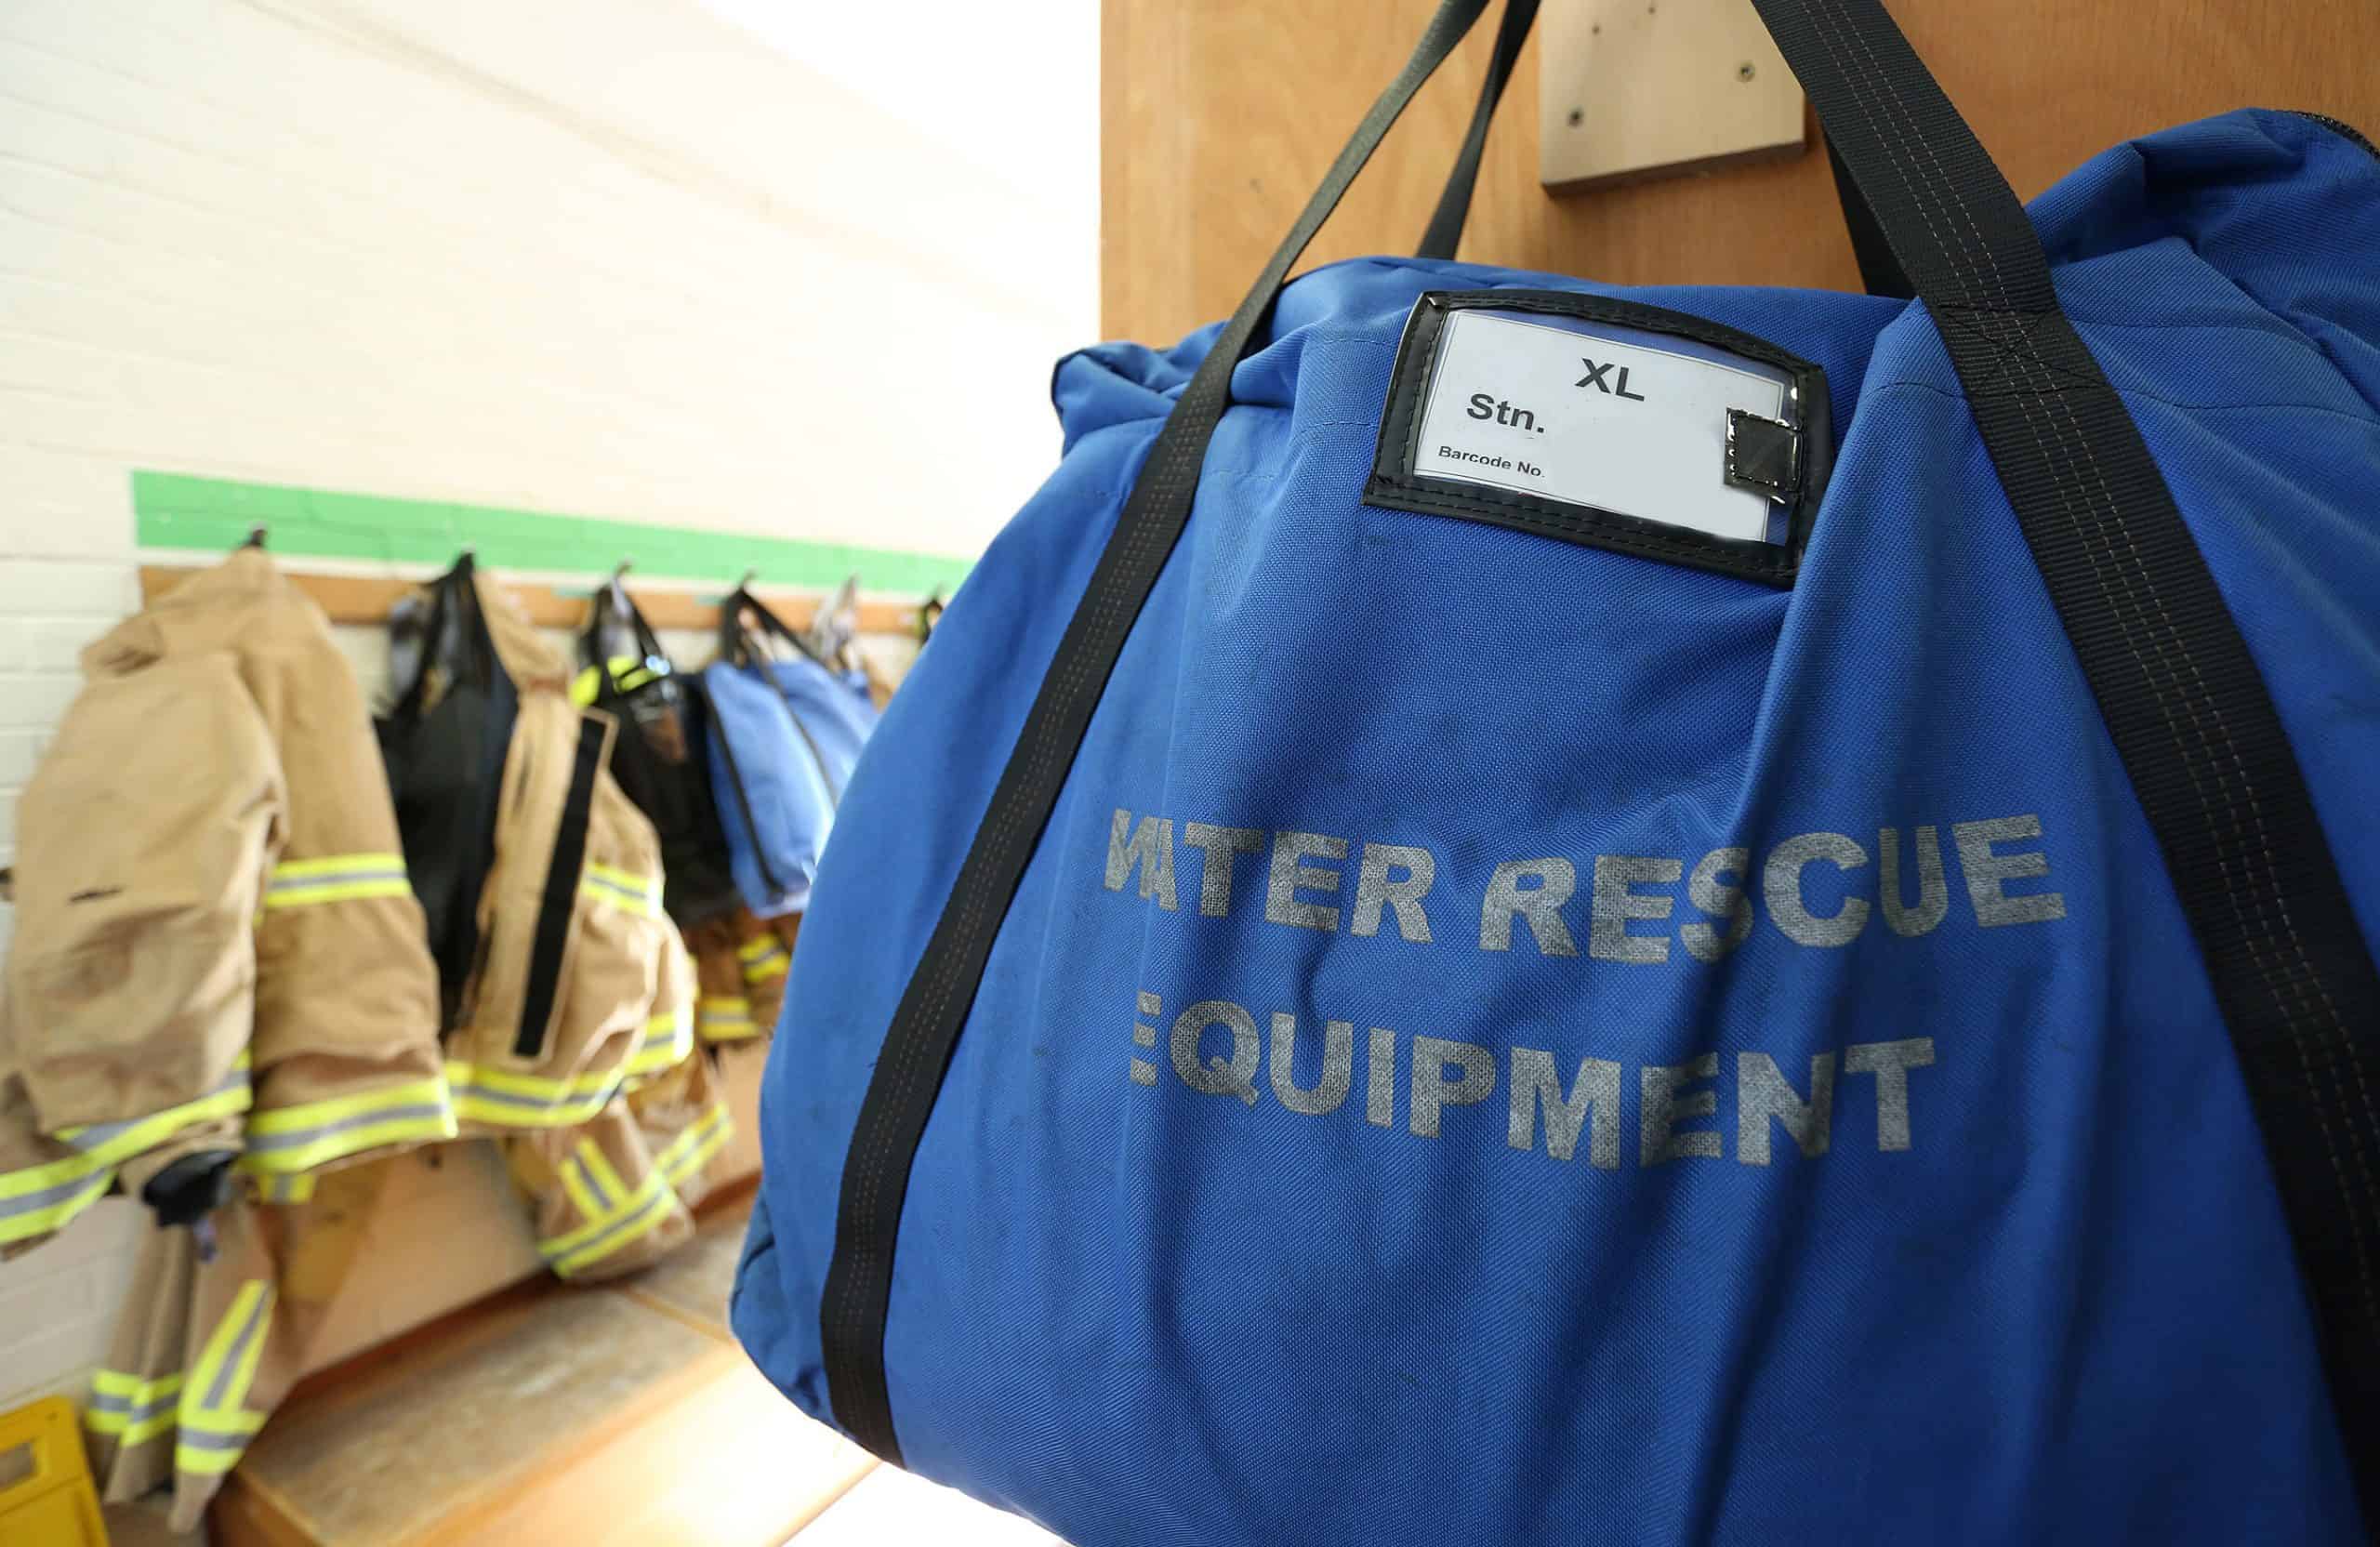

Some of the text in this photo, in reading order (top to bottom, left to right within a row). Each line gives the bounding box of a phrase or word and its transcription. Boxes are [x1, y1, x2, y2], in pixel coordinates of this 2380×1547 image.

[1575, 357, 1646, 402] XL
[1466, 392, 1545, 434] Stn.
[1437, 445, 1513, 469] Barcode
[1479, 813, 2067, 964] RESCUE
